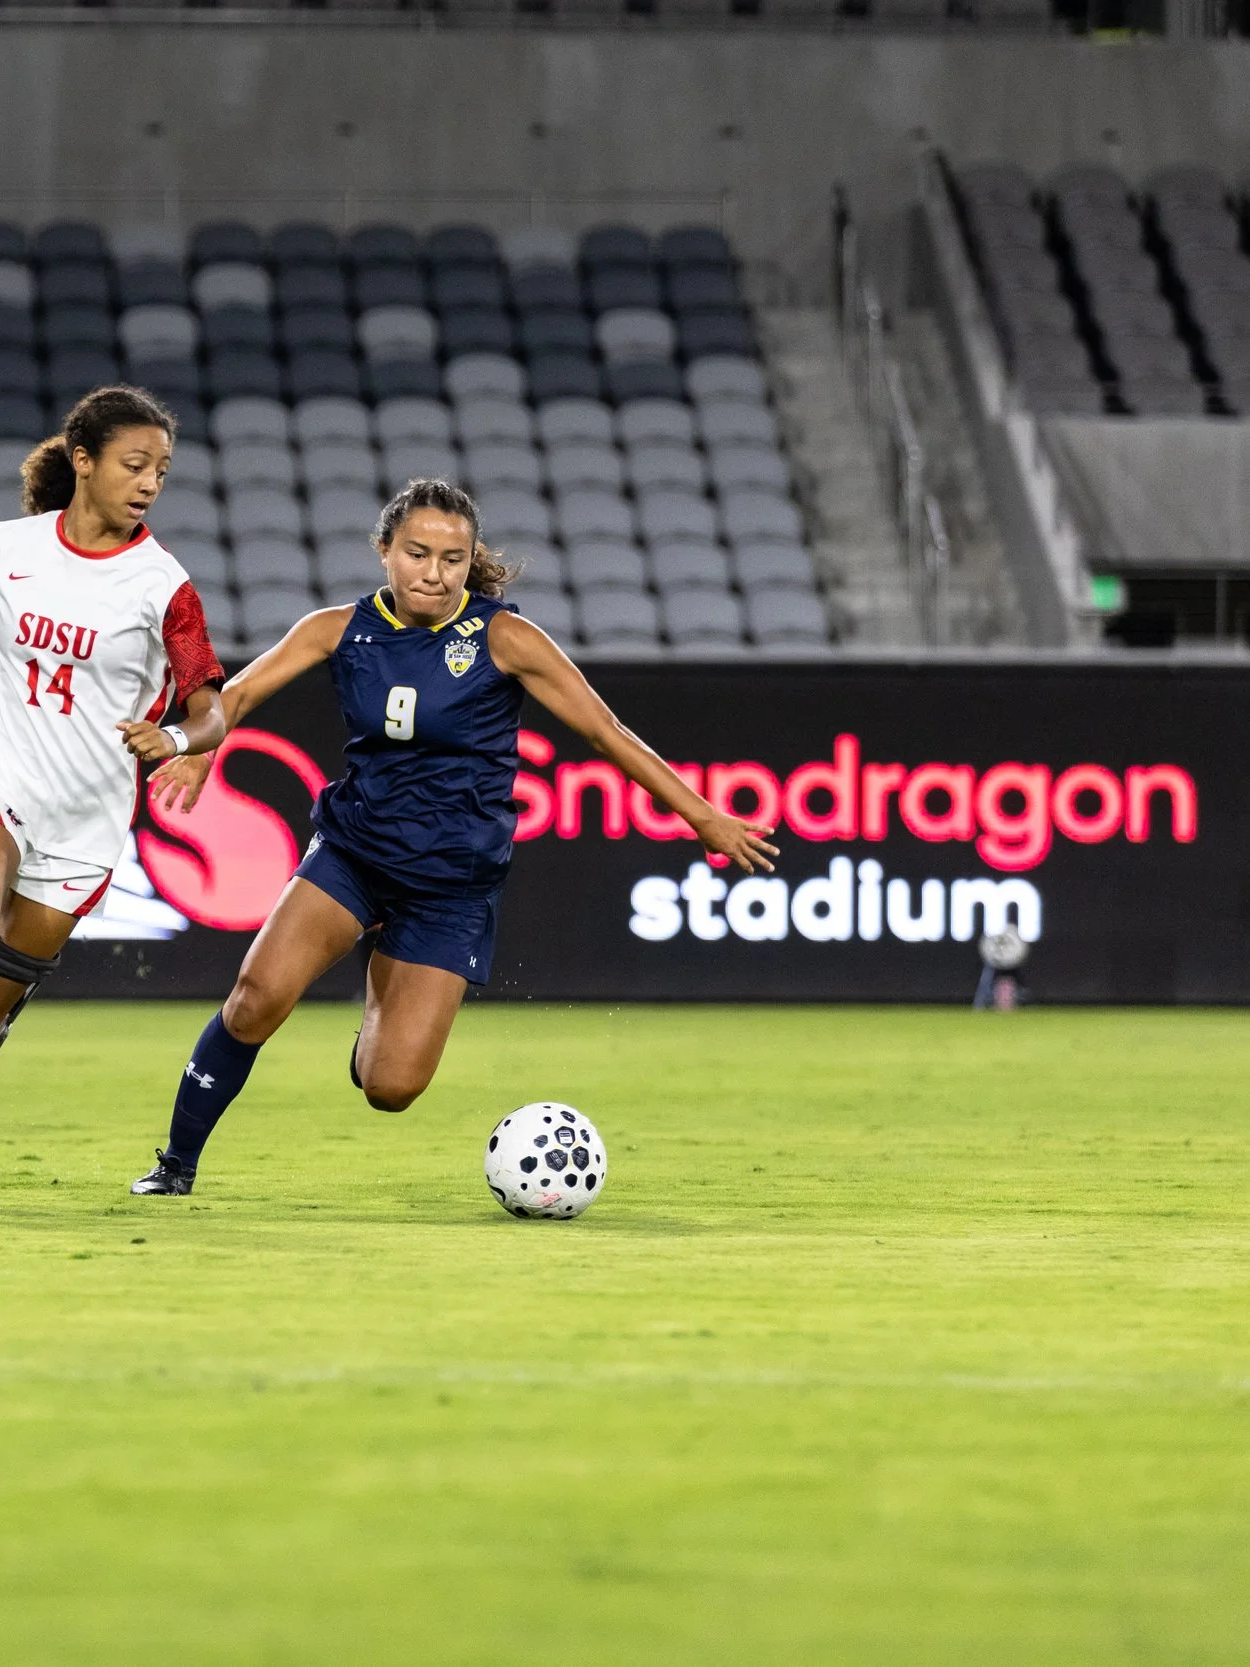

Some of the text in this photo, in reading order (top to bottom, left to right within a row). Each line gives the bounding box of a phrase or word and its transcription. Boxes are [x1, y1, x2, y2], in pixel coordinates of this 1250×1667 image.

[15, 612, 98, 660] SDSU
[25, 658, 75, 715] 14
[384, 686, 417, 740] 9
[629, 855, 1042, 942] stadium
